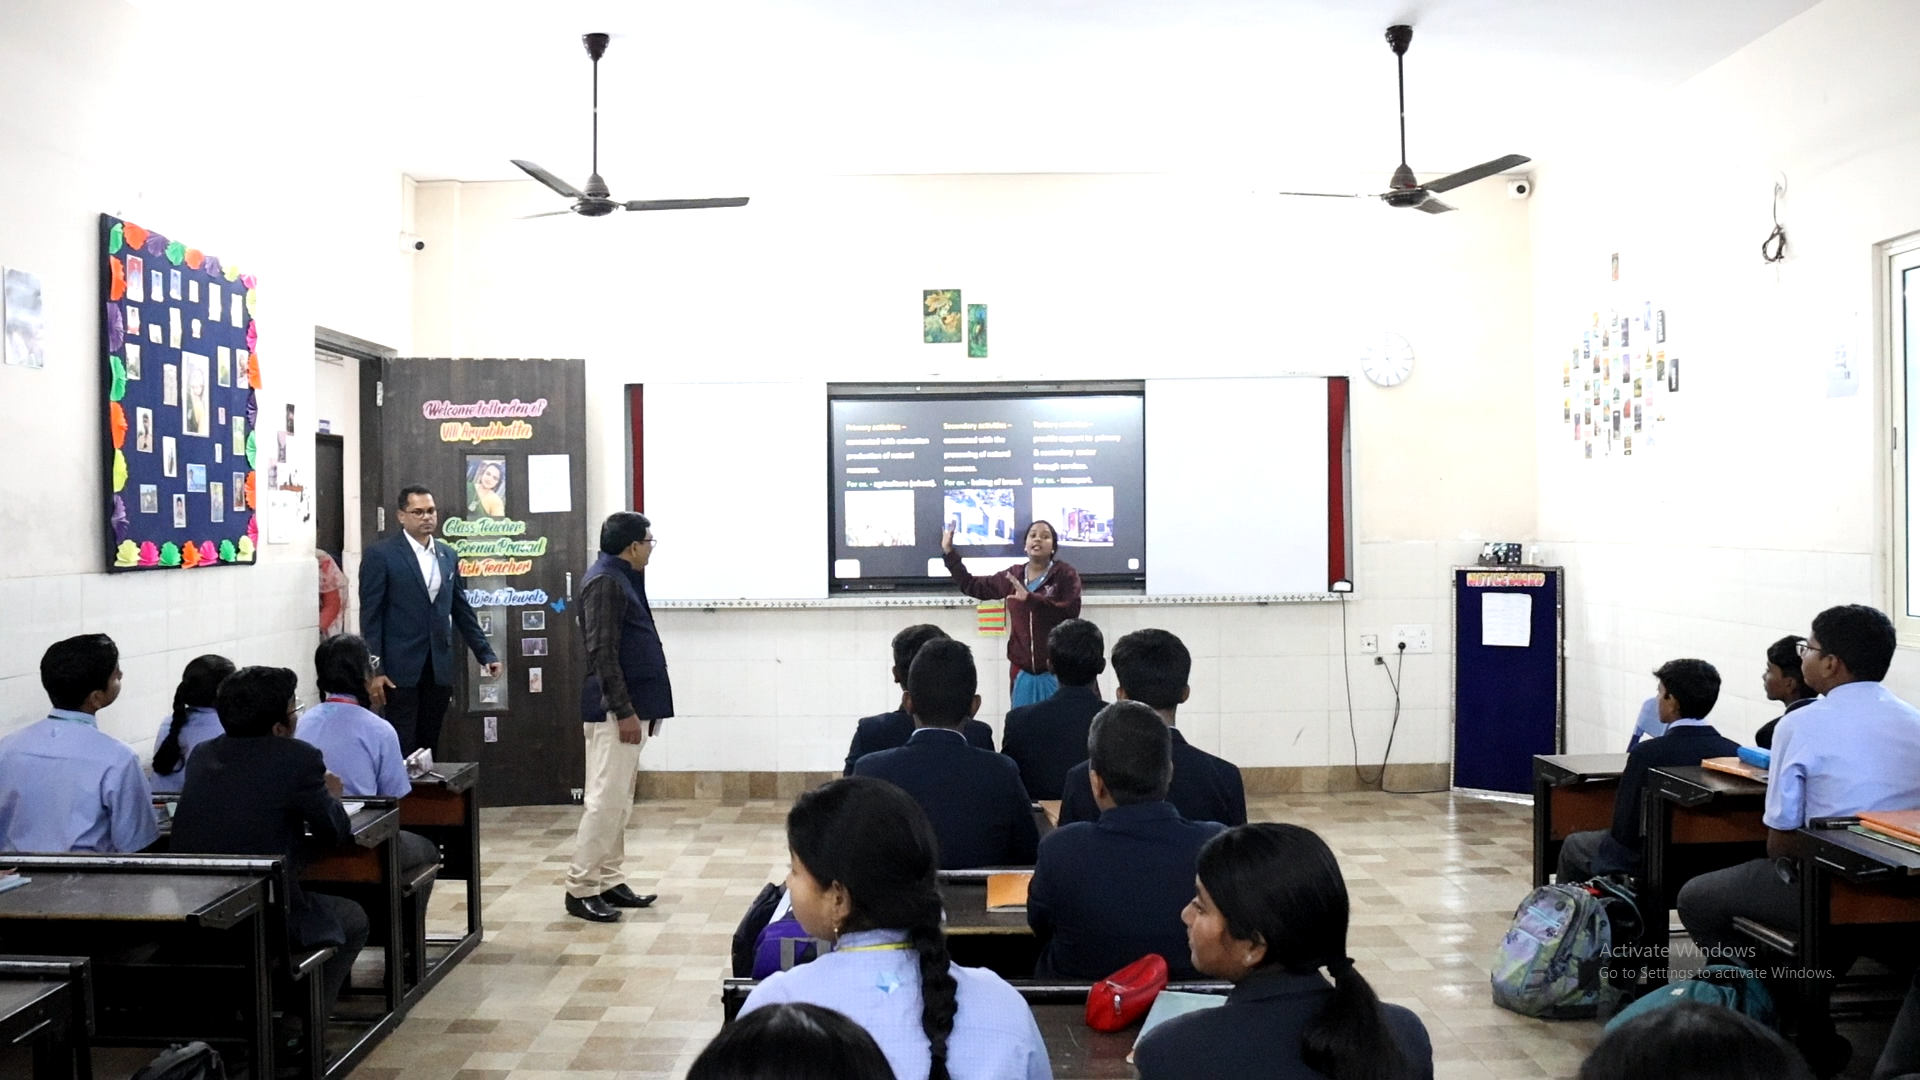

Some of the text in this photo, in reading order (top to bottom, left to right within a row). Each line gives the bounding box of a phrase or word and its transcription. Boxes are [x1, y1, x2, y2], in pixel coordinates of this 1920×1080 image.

[424, 399, 547, 417] Welcome to the den of
[845, 423, 871, 432] Primary
[872, 423, 901, 431] activities
[943, 422, 977, 431] Secondary
[1032, 421, 1059, 429] Tertiary
[442, 421, 531, 443] VIII Aryabhatta
[978, 435, 994, 444] with
[994, 435, 1006, 443] the
[1094, 434, 1122, 443] primary
[979, 450, 987, 458] of
[846, 480, 858, 488] For
[994, 478, 1002, 486] of
[444, 518, 526, 535] Class Teacher
[456, 539, 496, 556] Seema
[497, 538, 547, 556] Prasad
[481, 558, 531, 575] Teacher
[1467, 573, 1508, 587] NOTICE
[502, 587, 548, 605] Jewels
